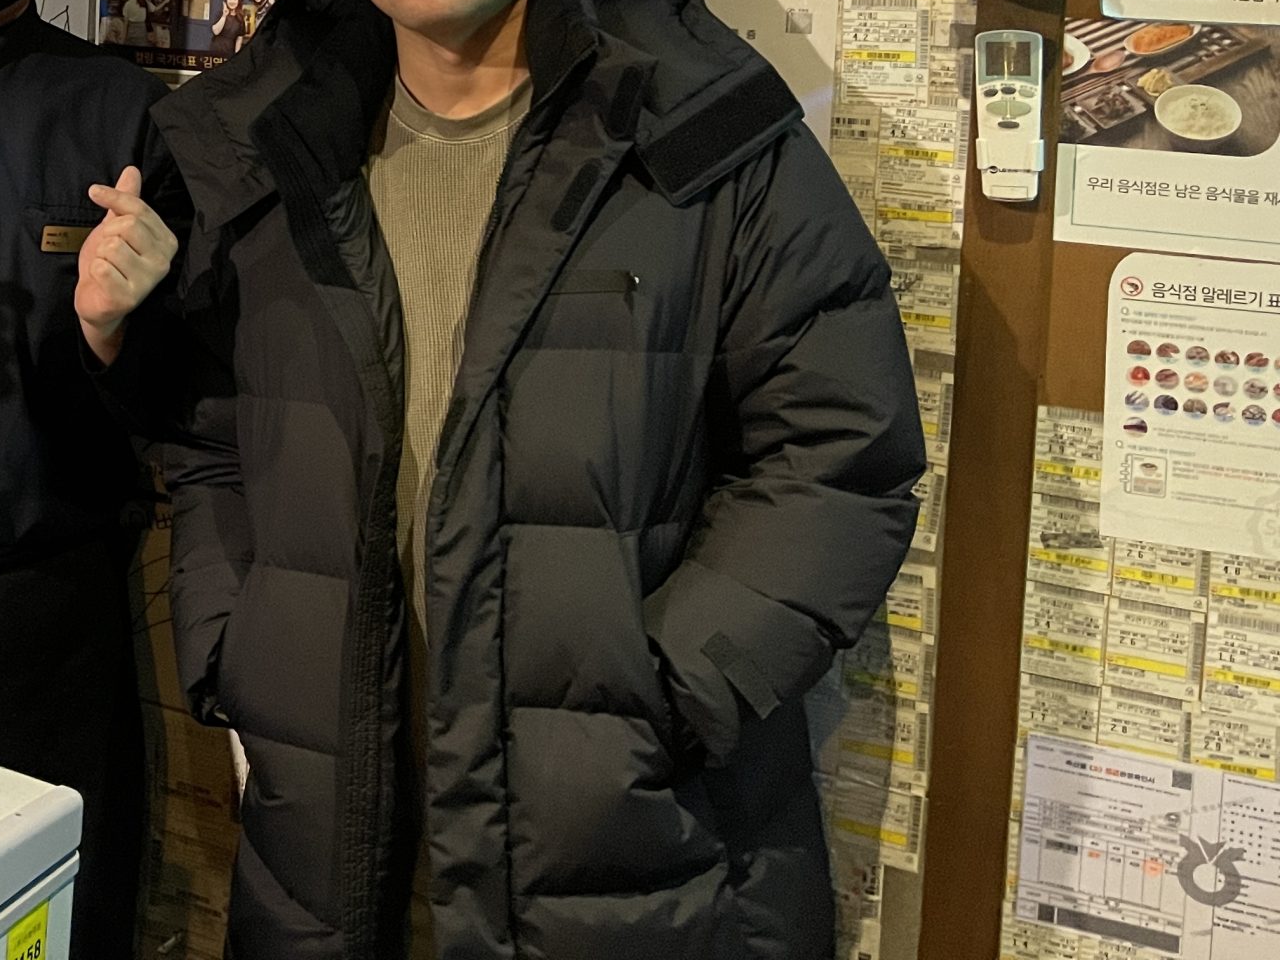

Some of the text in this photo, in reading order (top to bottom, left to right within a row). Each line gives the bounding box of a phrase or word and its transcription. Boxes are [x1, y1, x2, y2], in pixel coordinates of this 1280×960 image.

[1087, 176, 1260, 206] 우리 음식점은 남은 음식물을
[1152, 282, 1263, 308] 음식점 알레르기
